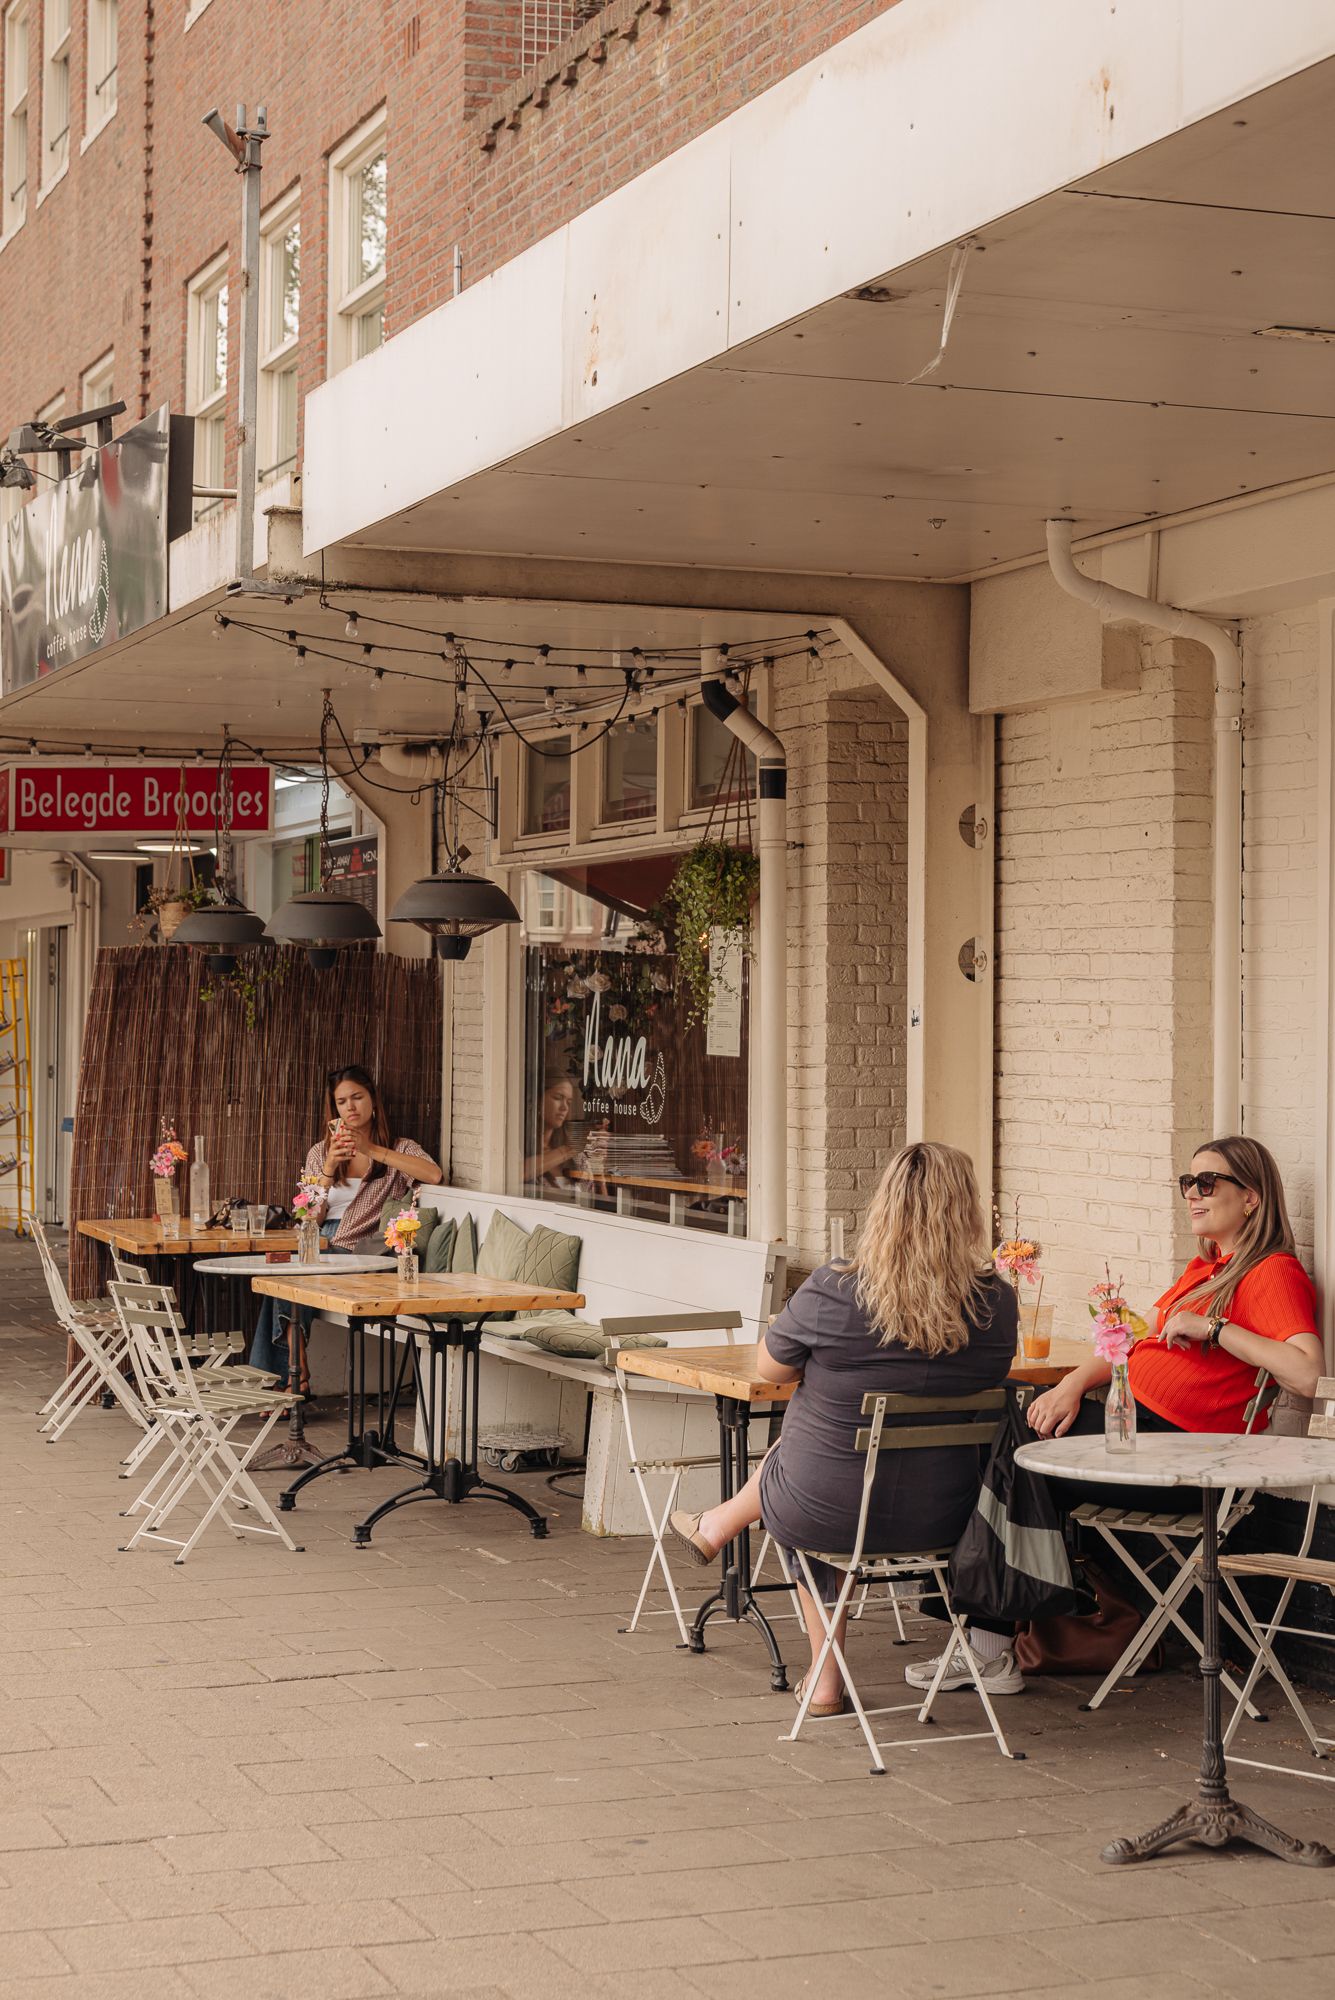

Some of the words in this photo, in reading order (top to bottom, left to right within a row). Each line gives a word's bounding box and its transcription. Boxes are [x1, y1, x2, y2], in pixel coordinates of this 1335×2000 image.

[46, 493, 97, 626] Nana
[47, 634, 66, 658] coffee
[69, 625, 87, 646] house
[21, 774, 132, 828] Belegde
[144, 774, 263, 826] Broodjes
[583, 991, 651, 1090] Nana
[583, 1099, 609, 1114] coffee
[614, 1100, 637, 1115] house
